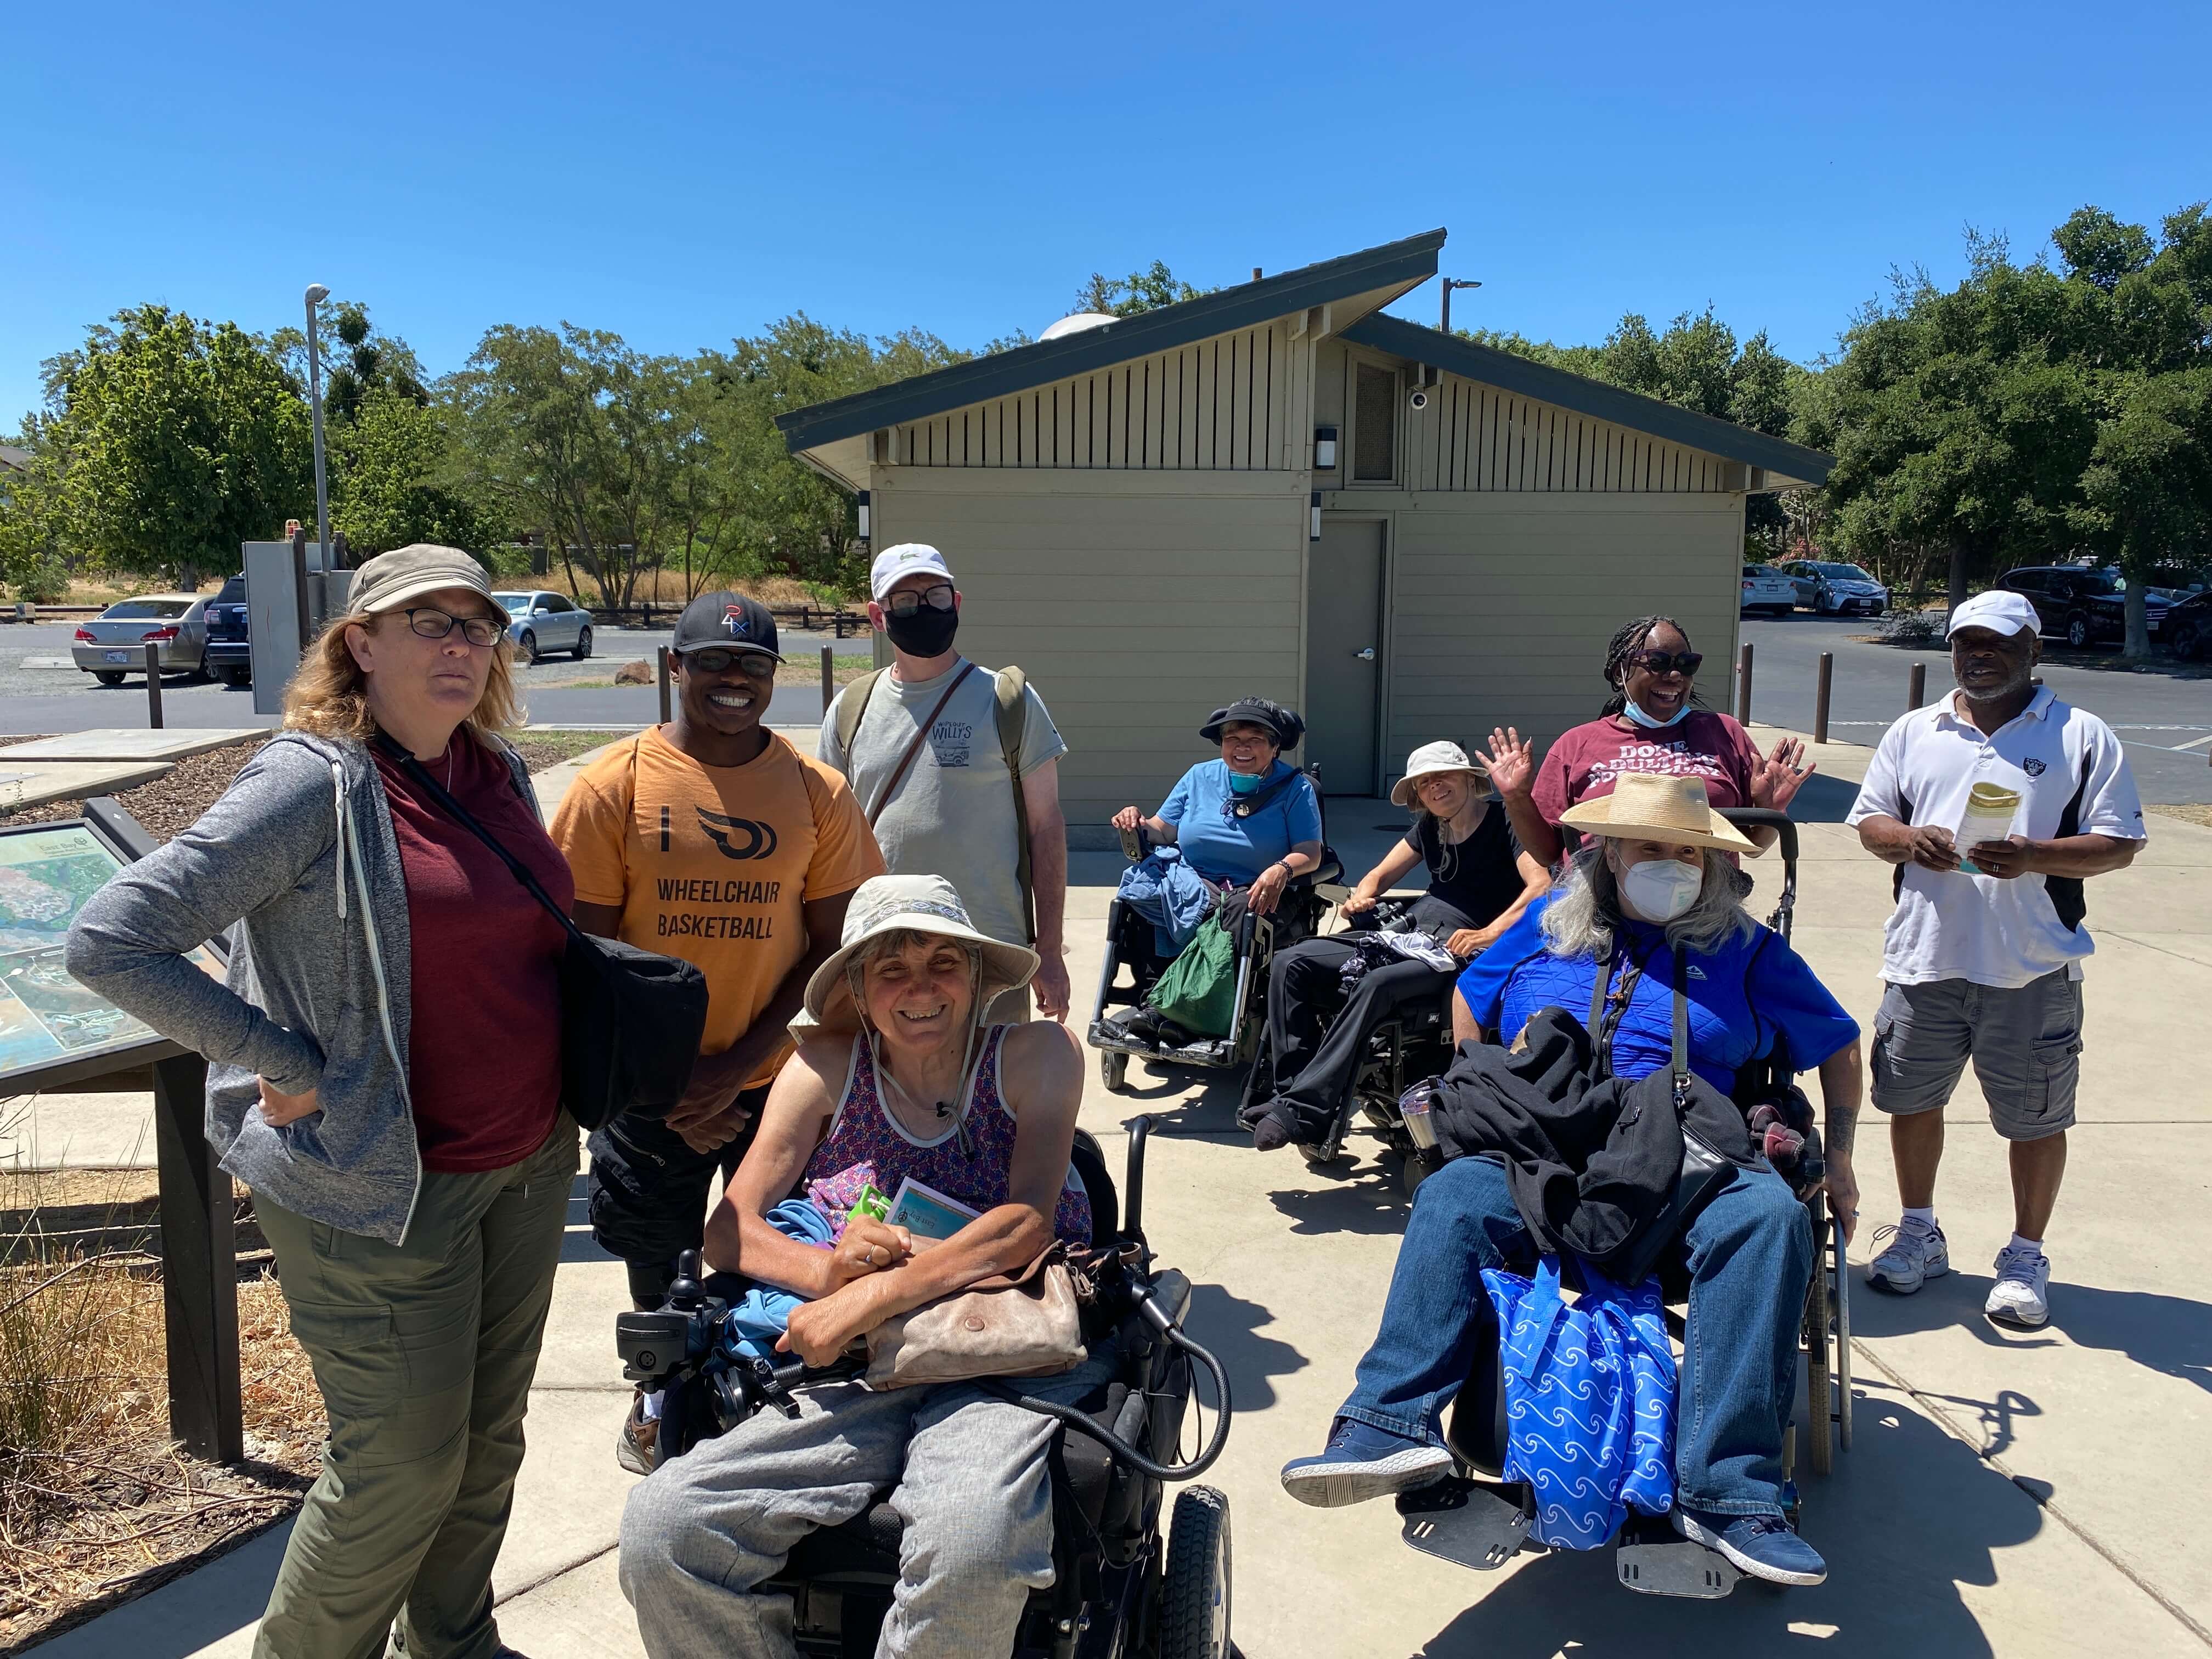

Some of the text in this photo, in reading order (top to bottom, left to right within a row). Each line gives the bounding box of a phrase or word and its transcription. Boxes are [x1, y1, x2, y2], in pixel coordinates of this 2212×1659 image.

[933, 726, 972, 740] WILLY'S
[1619, 741, 1689, 759] DONE
[661, 805, 669, 852] I
[657, 878, 780, 904] WHEELCHAIR
[658, 913, 772, 939] BASKETBALL
